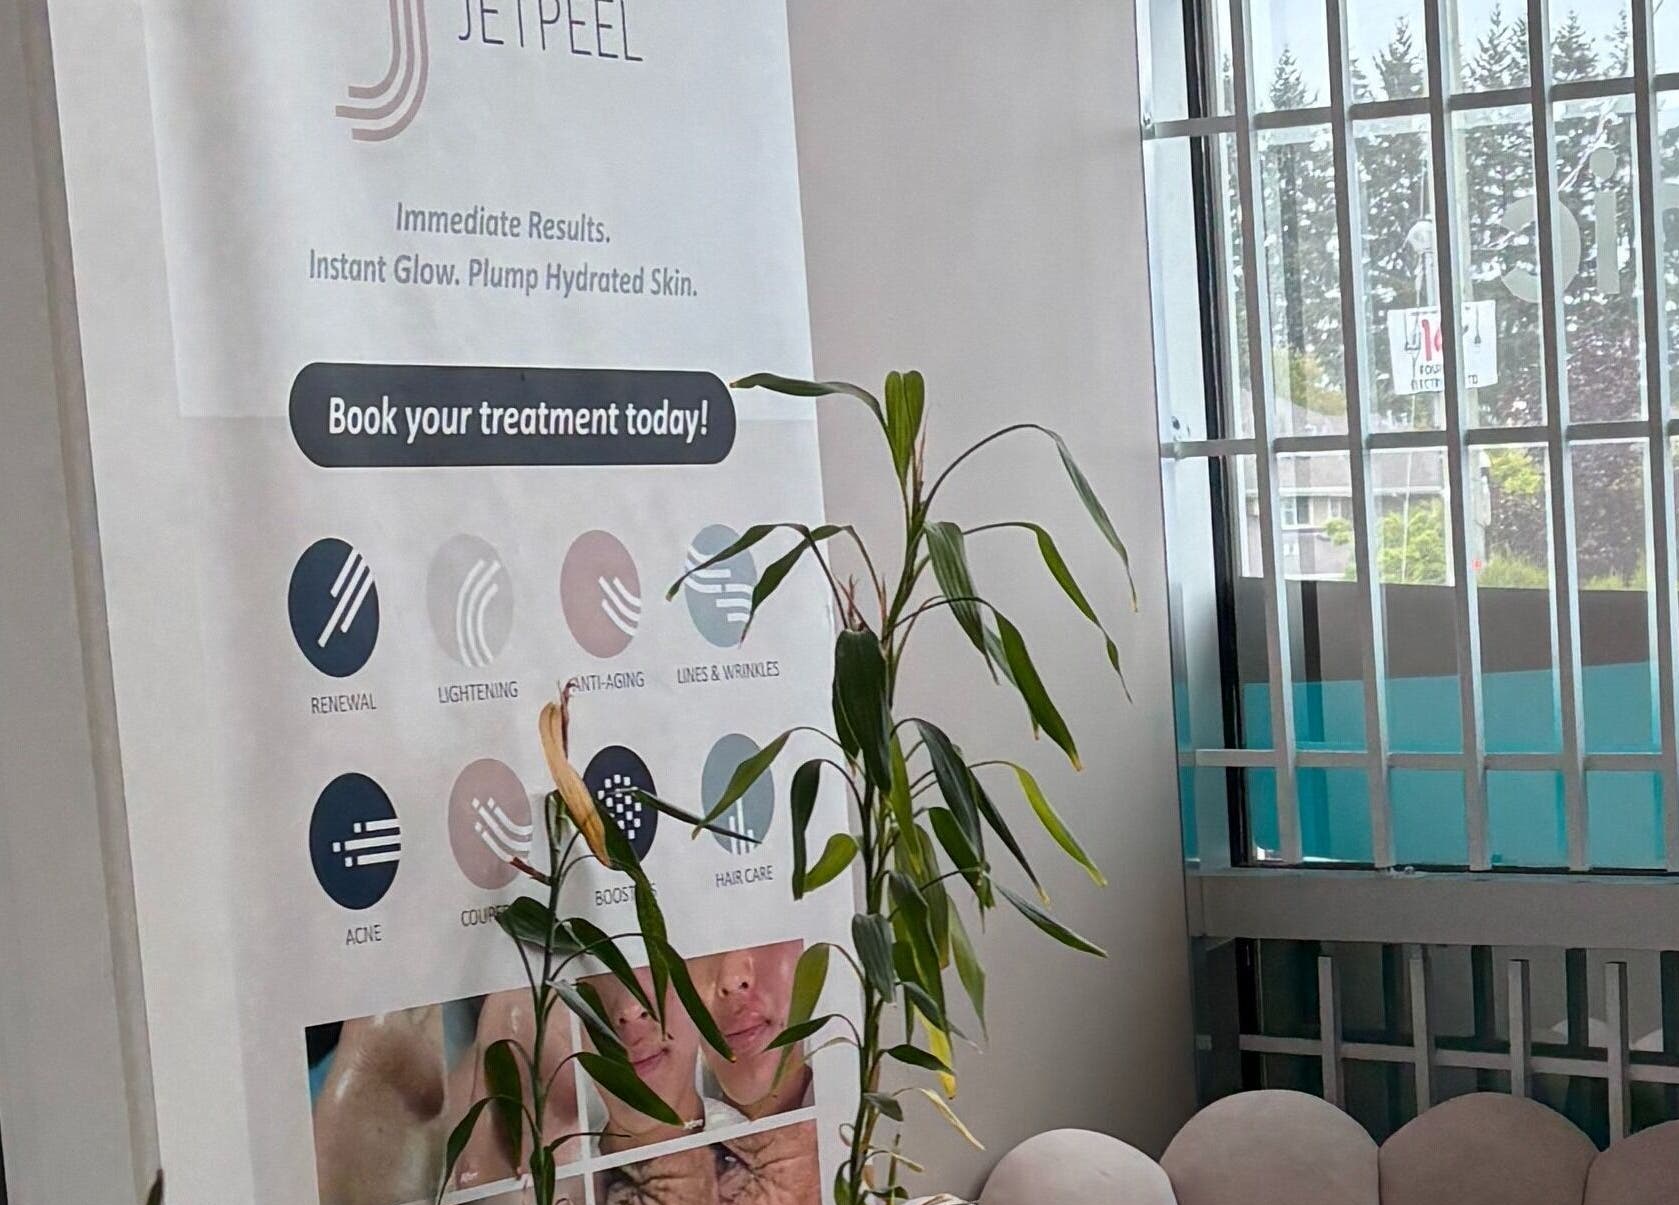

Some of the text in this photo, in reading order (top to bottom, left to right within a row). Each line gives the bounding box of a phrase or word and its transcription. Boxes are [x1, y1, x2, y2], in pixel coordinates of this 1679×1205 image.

[396, 202, 611, 244] Immediate Results.
[310, 249, 698, 299] Instant Glow. Plump Hydrated Skin.
[328, 396, 709, 444] Book your treatment today!
[677, 660, 781, 684] LINES & WRINKLES
[311, 692, 377, 714] RENEWAL
[438, 680, 519, 704] LIGHTENING
[715, 865, 774, 888] HAIR CARE
[595, 882, 658, 906] BOOSTS
[345, 924, 383, 946] ACNE
